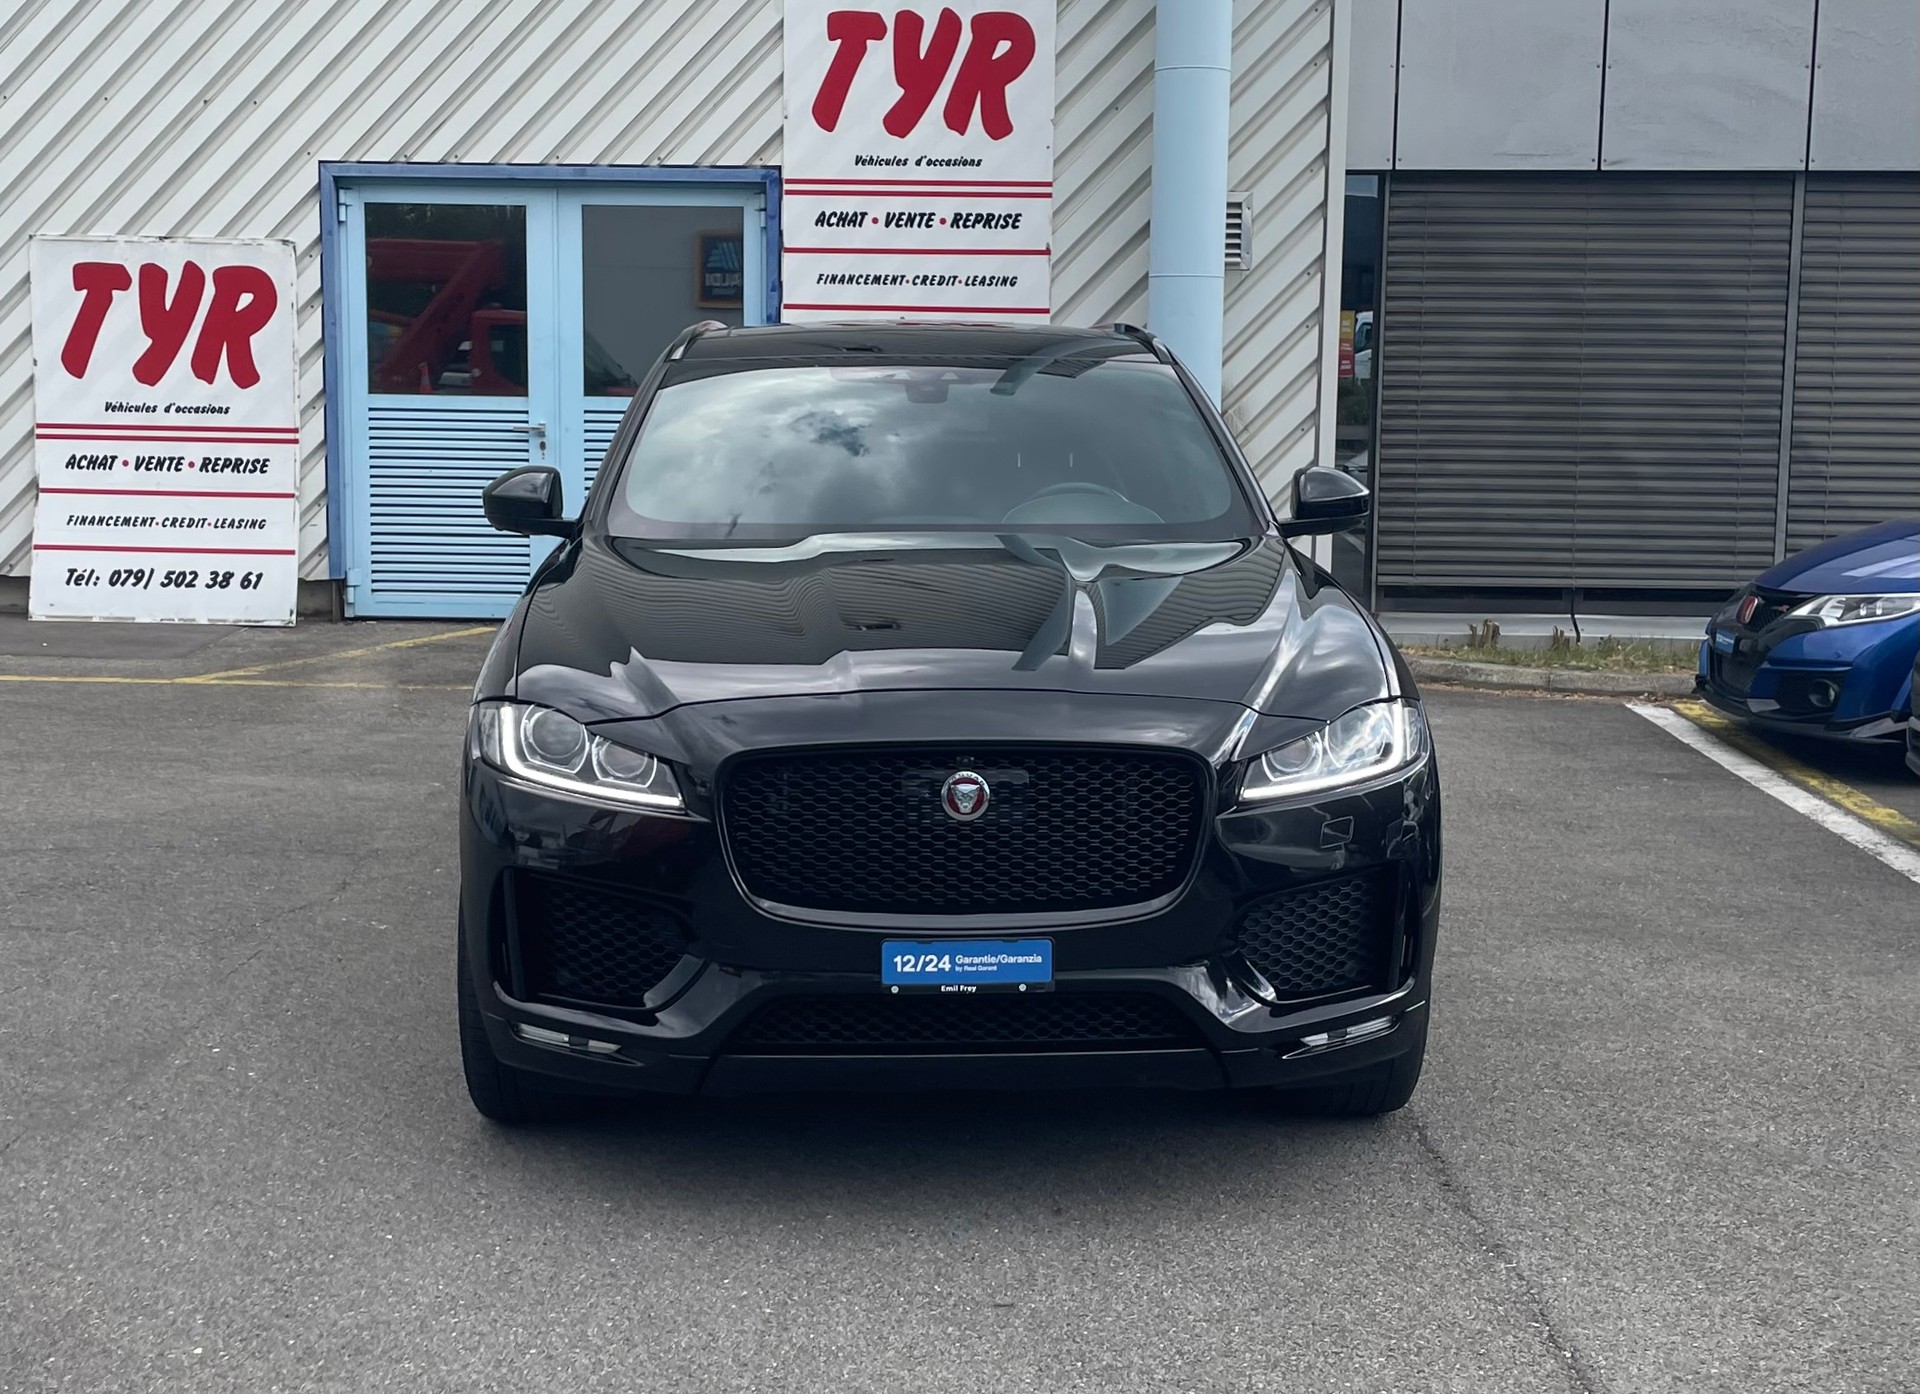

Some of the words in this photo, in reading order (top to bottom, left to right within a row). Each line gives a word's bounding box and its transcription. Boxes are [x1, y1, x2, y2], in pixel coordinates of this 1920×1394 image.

[812, 7, 1036, 140] TYR
[855, 154, 908, 167] Véhicules
[915, 154, 982, 167] d'occasions
[815, 211, 868, 228] ACHAT
[885, 212, 936, 228] VENTE
[950, 212, 1022, 230] REPRISE
[816, 273, 905, 286] FINANCEMENT
[912, 274, 958, 287] CREDIT
[964, 275, 1018, 288] LEASING
[61, 261, 277, 389] TYR
[104, 401, 157, 414] Véhicules
[164, 402, 230, 415] d'occasions
[65, 454, 118, 471] ACHAT
[134, 456, 185, 472] VENTE
[199, 457, 270, 474] REPRISE
[66, 515, 154, 528] FINANCEMENT
[161, 517, 207, 529] CREDIT
[214, 518, 266, 530] LEASING
[65, 568, 101, 587] Tél:
[160, 570, 199, 589] 502
[205, 571, 234, 589] 38
[240, 571, 263, 590] 61
[893, 954, 951, 973] 12/24
[955, 953, 1043, 964] Garantie/Garanzia
[940, 984, 959, 993] Emil
